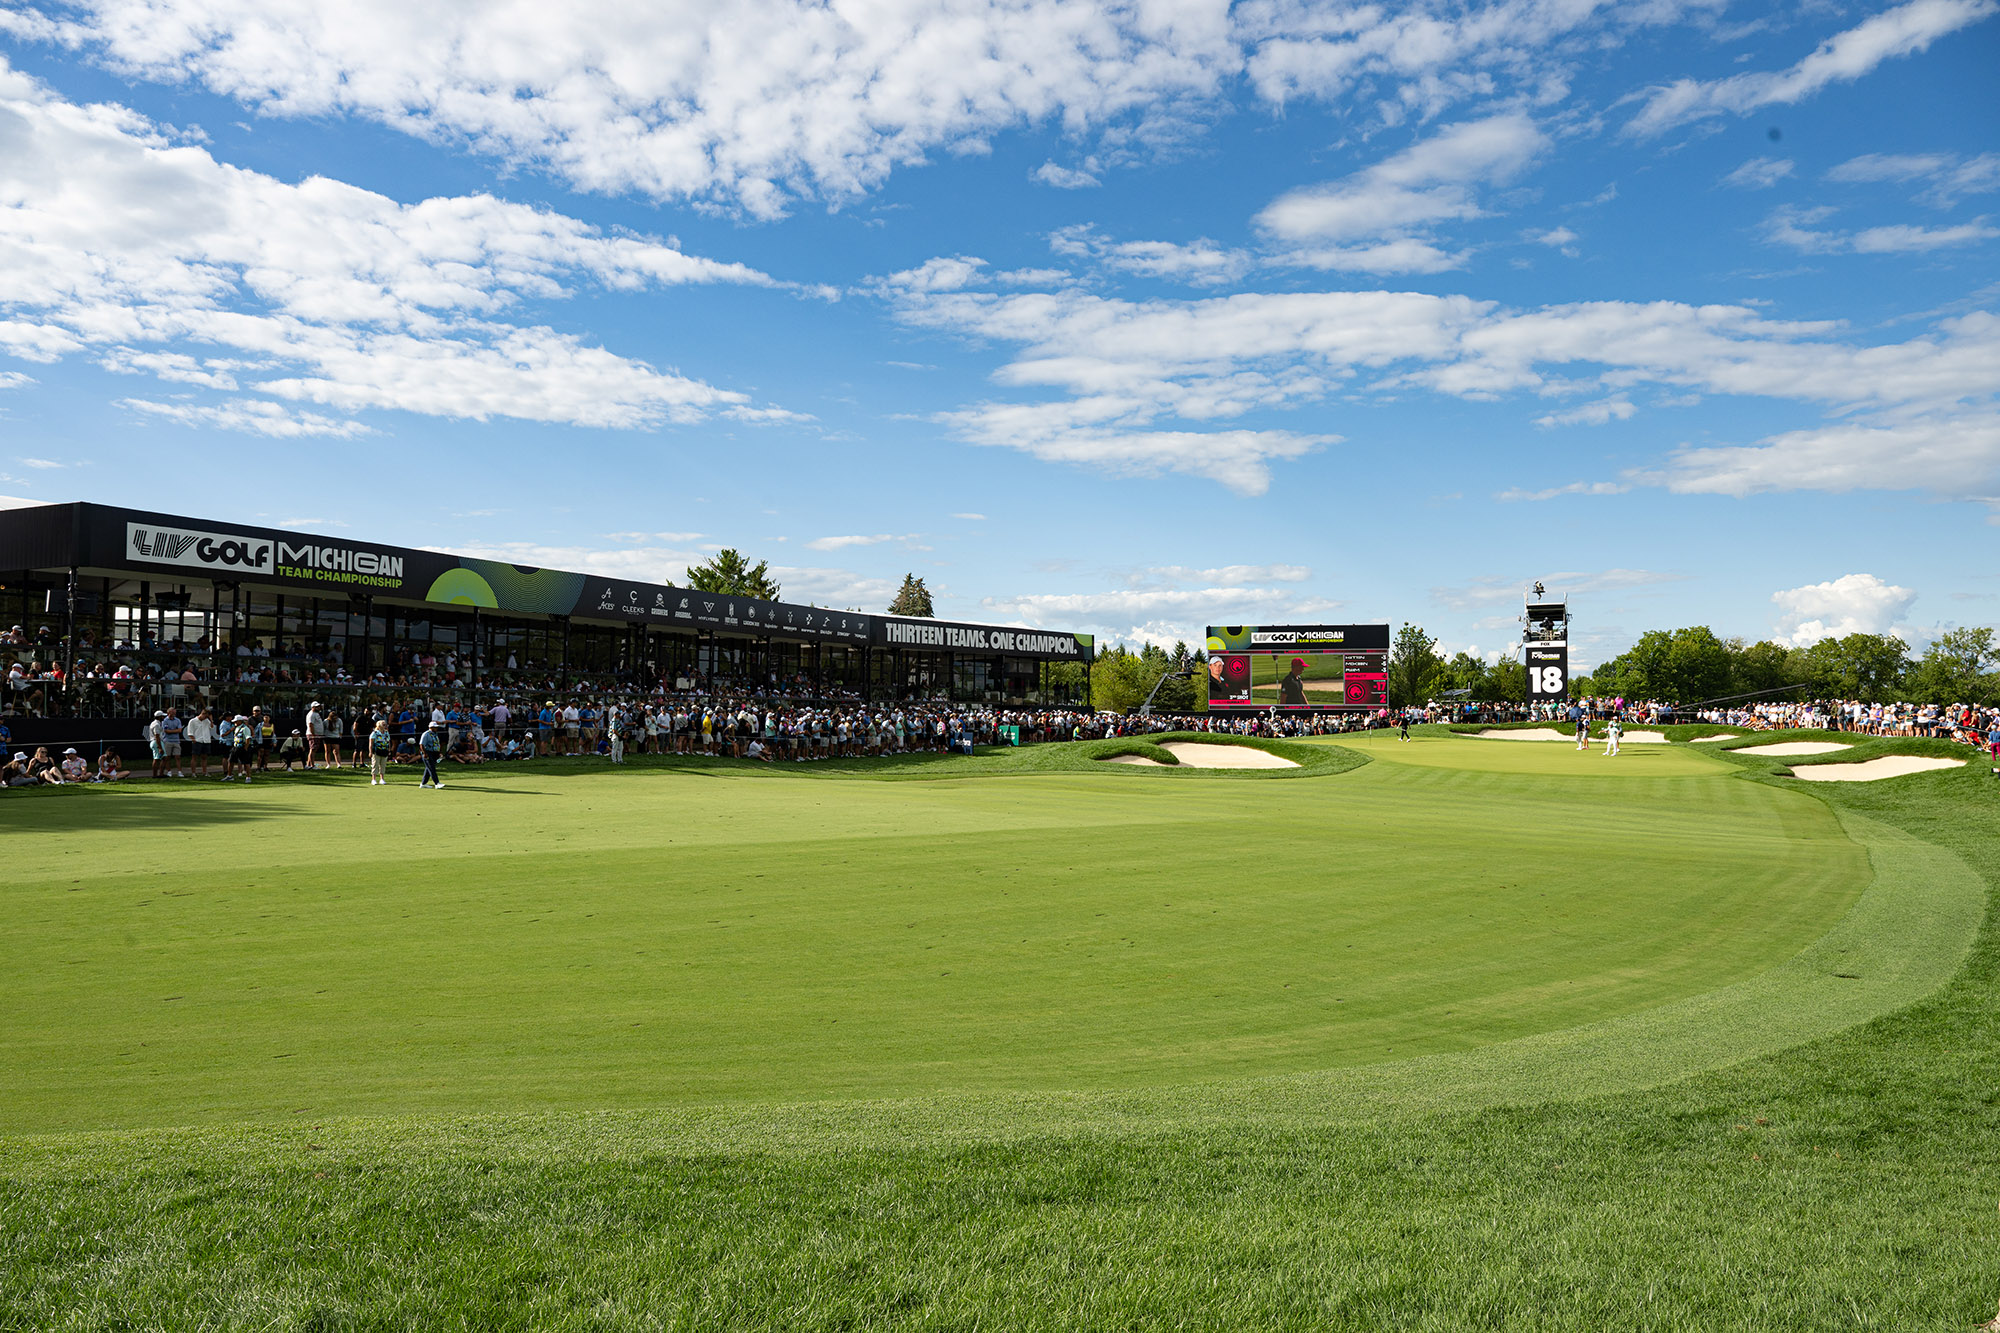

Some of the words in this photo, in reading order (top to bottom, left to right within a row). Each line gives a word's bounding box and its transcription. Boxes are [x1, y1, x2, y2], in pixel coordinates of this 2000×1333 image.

[133, 529, 199, 559] LIV
[196, 537, 269, 568] GOLF
[277, 541, 403, 578] MICHIGAN
[277, 565, 313, 579] TEAM
[315, 570, 403, 589] CHAMPIONSHIP
[622, 605, 645, 614] CLEEKS
[885, 622, 944, 645] THIRTEEN
[945, 627, 989, 649] TEAMS.
[989, 631, 1015, 650] ONE
[1015, 633, 1078, 655] CHAMPION.
[1271, 633, 1294, 641] GOLF
[1296, 631, 1344, 639] MICHIGAN
[1529, 666, 1564, 694] 18
[1379, 693, 1387, 704] 2
